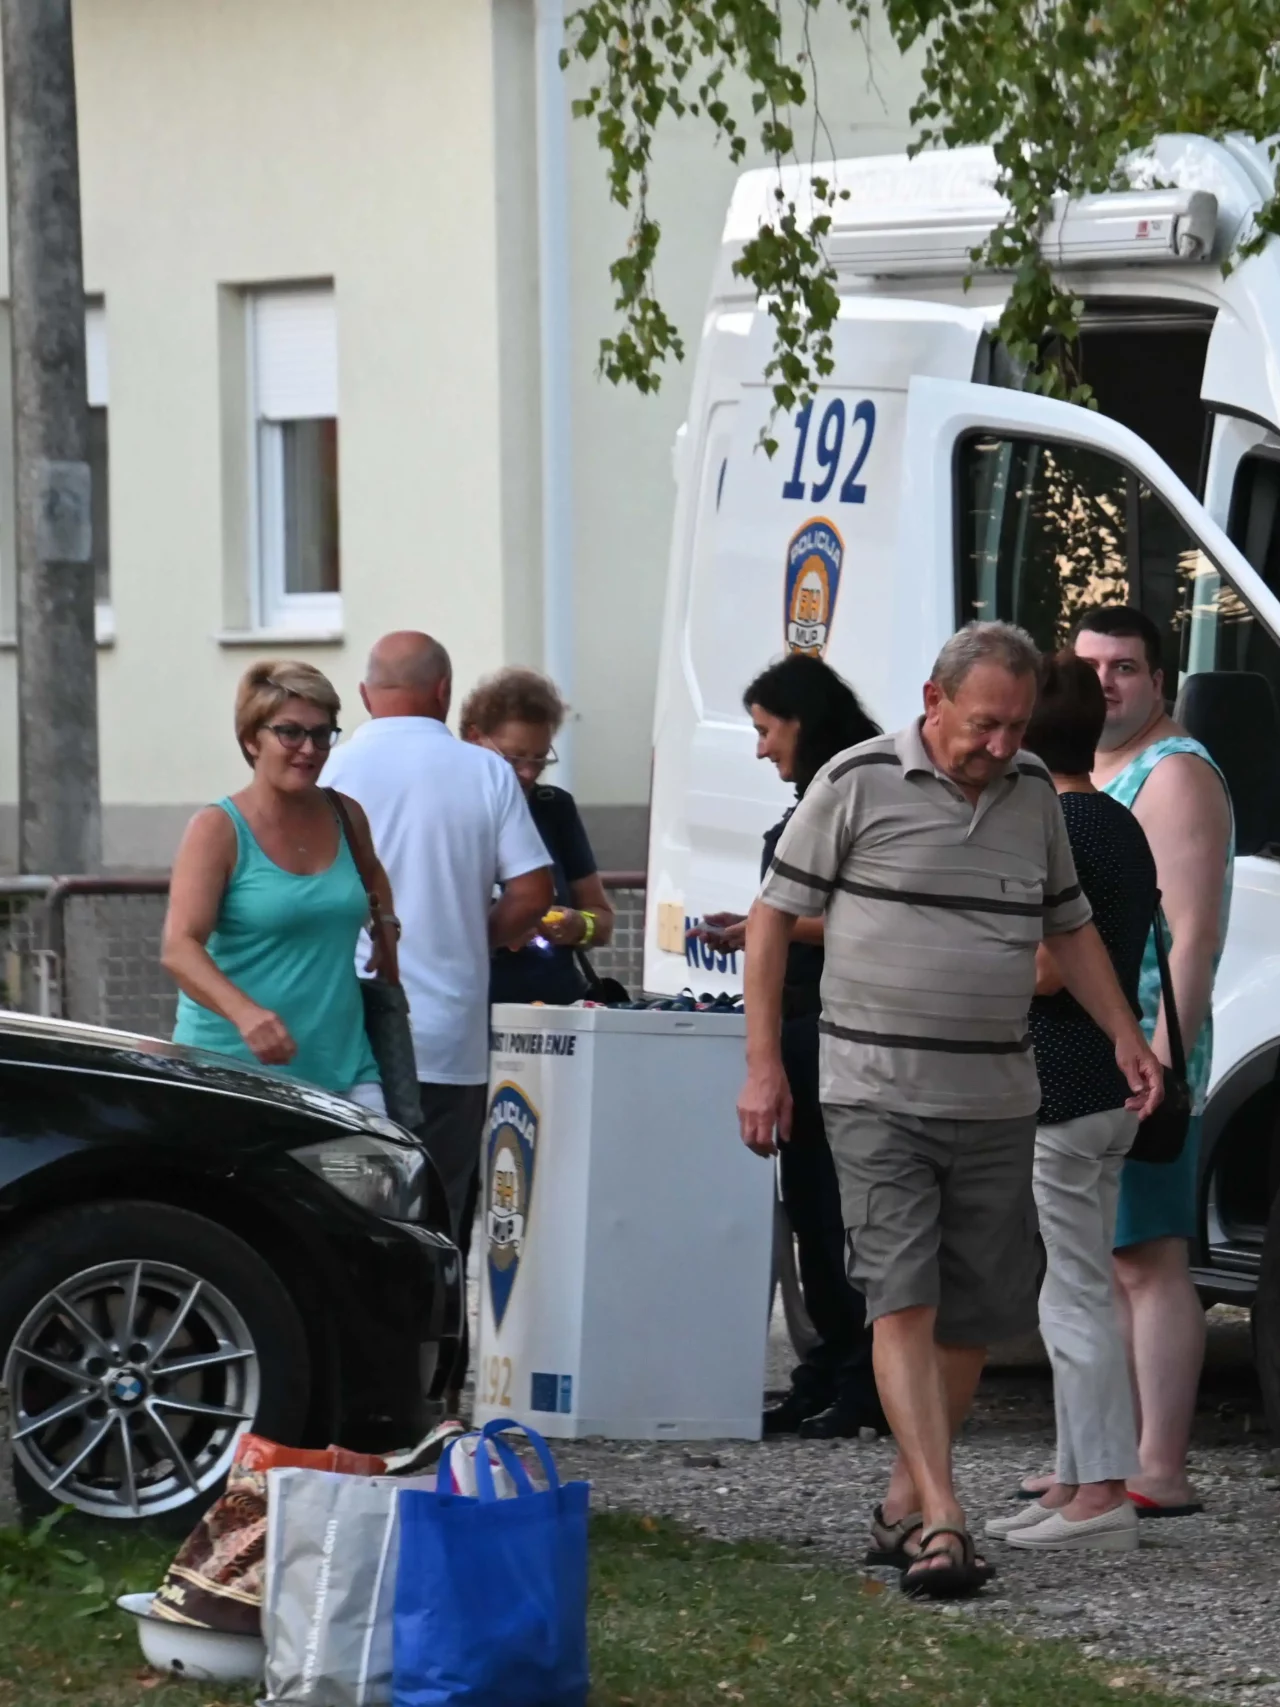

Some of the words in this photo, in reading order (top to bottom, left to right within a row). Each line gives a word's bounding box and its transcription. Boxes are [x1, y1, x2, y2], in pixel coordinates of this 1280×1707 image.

[782, 397, 876, 504] 192
[790, 530, 842, 570] POLICIJA
[795, 627, 819, 645] MUP
